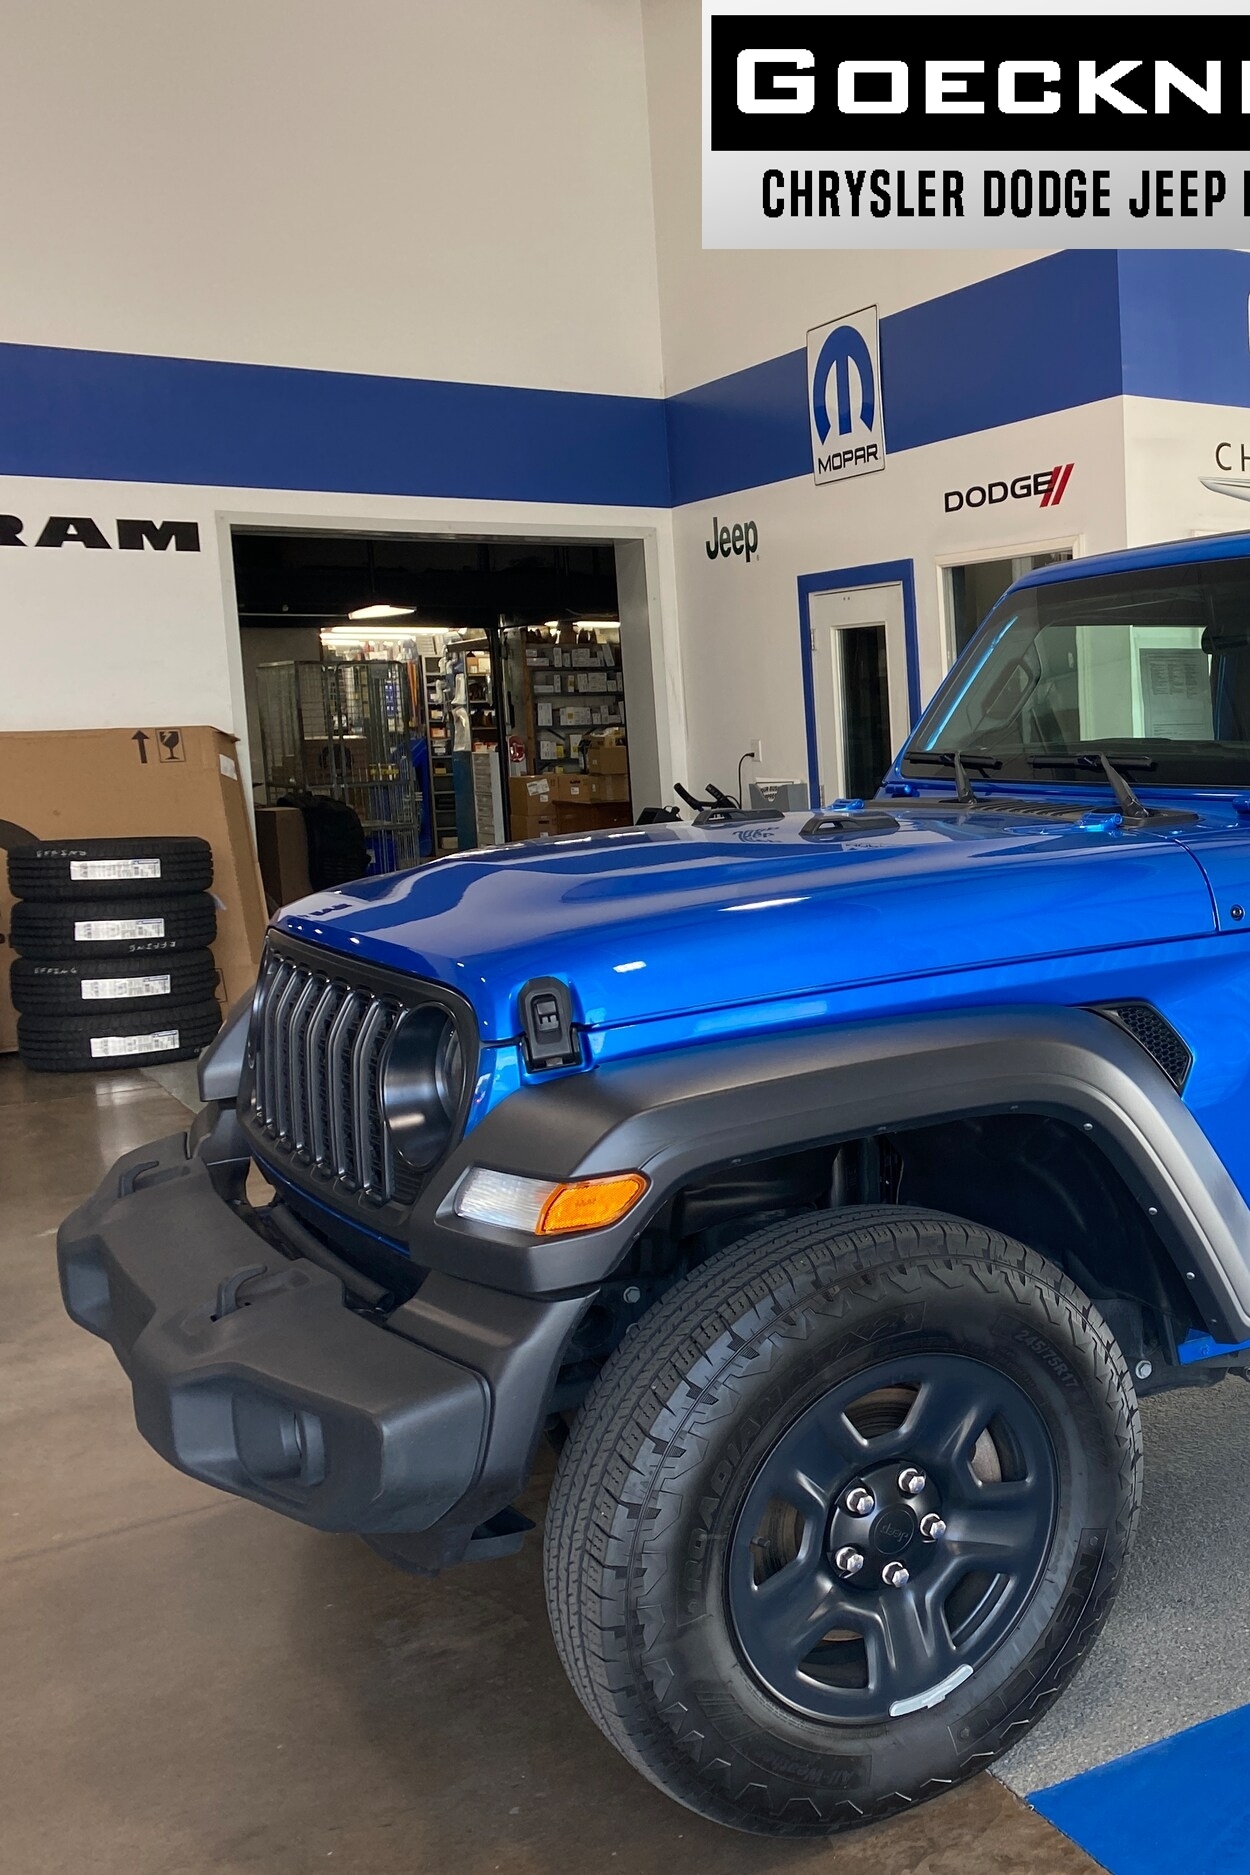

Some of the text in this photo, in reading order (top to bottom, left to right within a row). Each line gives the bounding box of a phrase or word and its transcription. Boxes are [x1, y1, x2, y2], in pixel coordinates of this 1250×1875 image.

[818, 443, 879, 475] MOPAR
[944, 470, 1056, 513] DODGE
[706, 516, 758, 562] Jeep
[1013, 1329, 1080, 1389] 245/75R17
